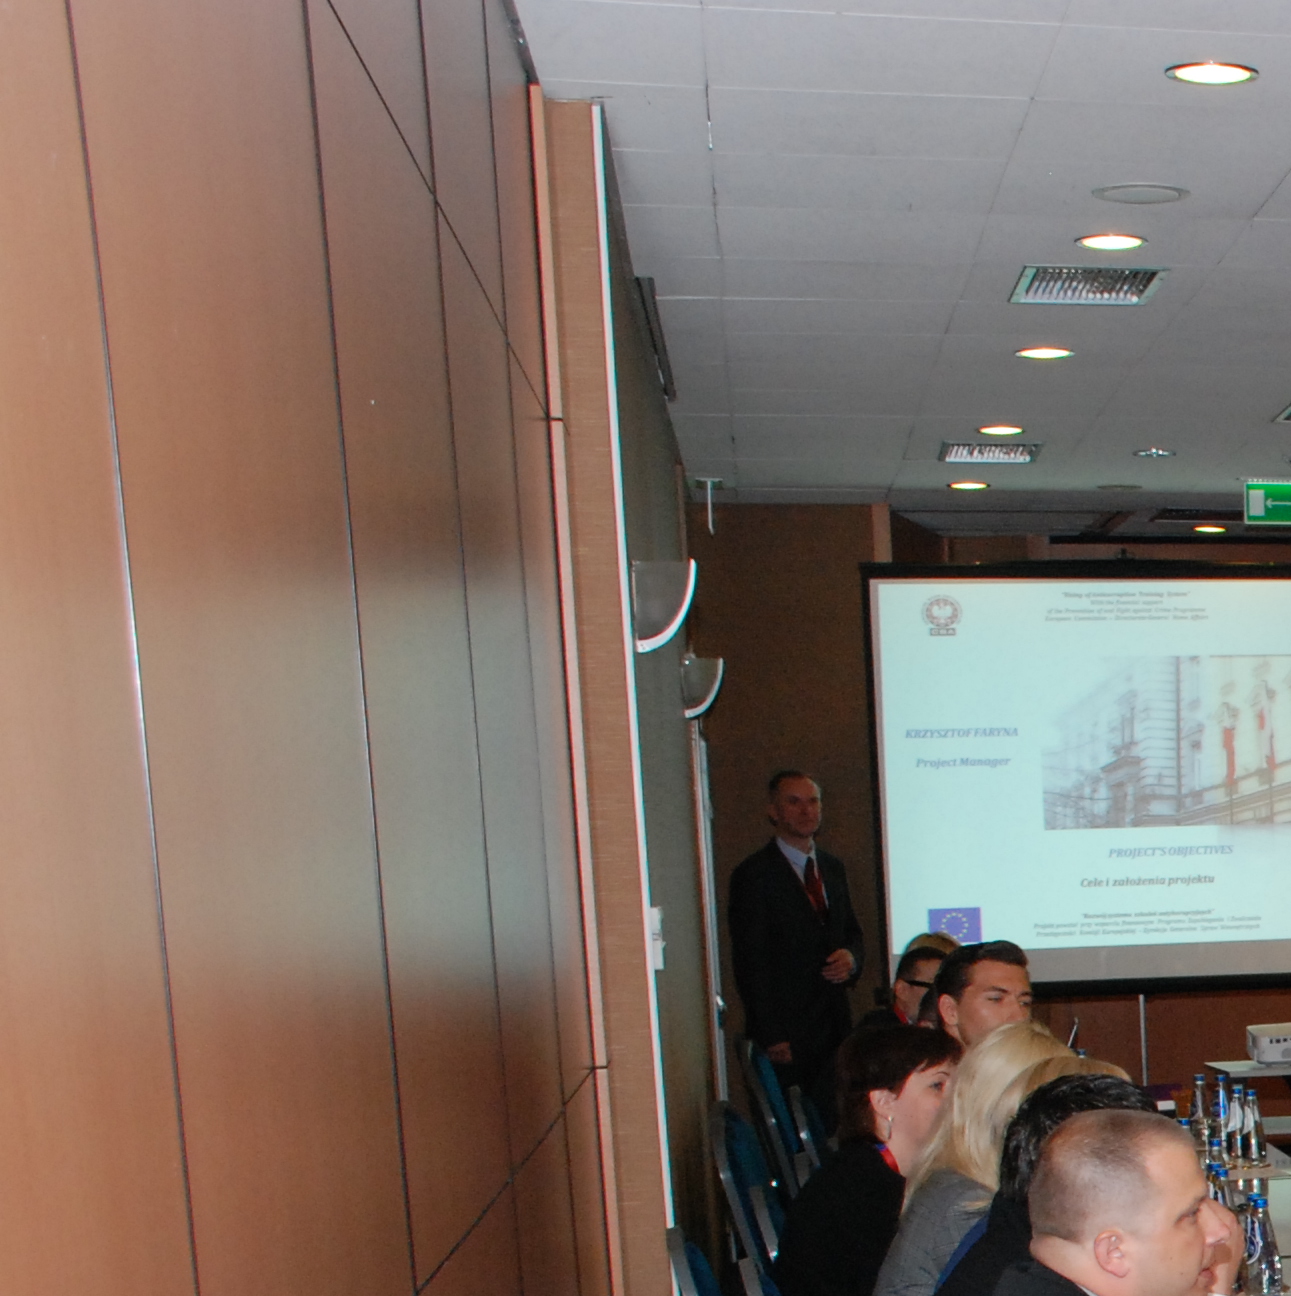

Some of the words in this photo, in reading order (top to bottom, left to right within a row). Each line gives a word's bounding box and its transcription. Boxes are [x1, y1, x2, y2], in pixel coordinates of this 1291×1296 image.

[905, 728, 974, 738] KRZYSZTOF
[915, 758, 957, 770] Project
[959, 757, 1011, 768] Manager
[1168, 845, 1235, 859] OBJECTIVES
[1080, 877, 1104, 888] Cele
[1167, 874, 1215, 887] projektu
